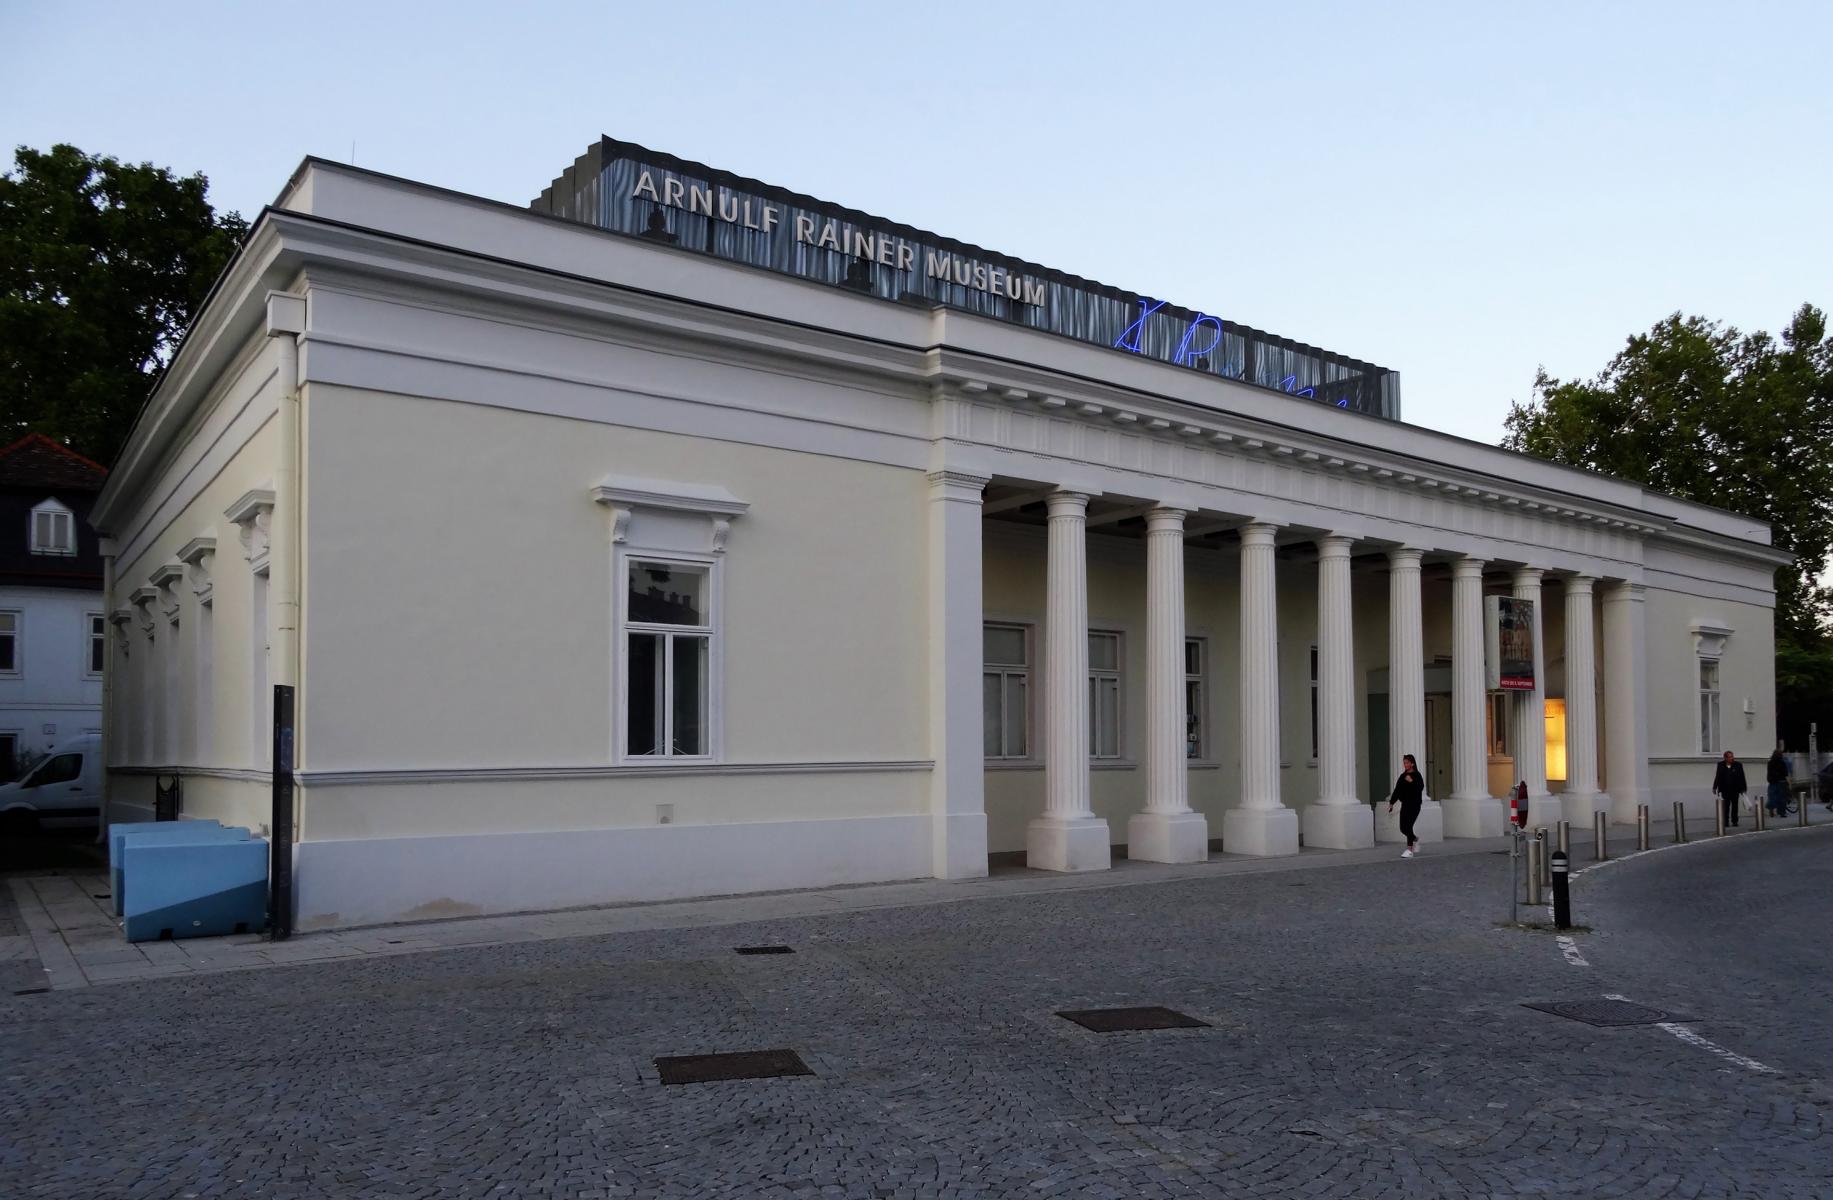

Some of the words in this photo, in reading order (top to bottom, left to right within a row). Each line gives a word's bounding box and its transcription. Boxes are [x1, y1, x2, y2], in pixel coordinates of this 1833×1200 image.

[632, 171, 778, 232] ARNULF
[796, 215, 912, 272] RAINER
[928, 252, 1045, 307] MUSEUM
